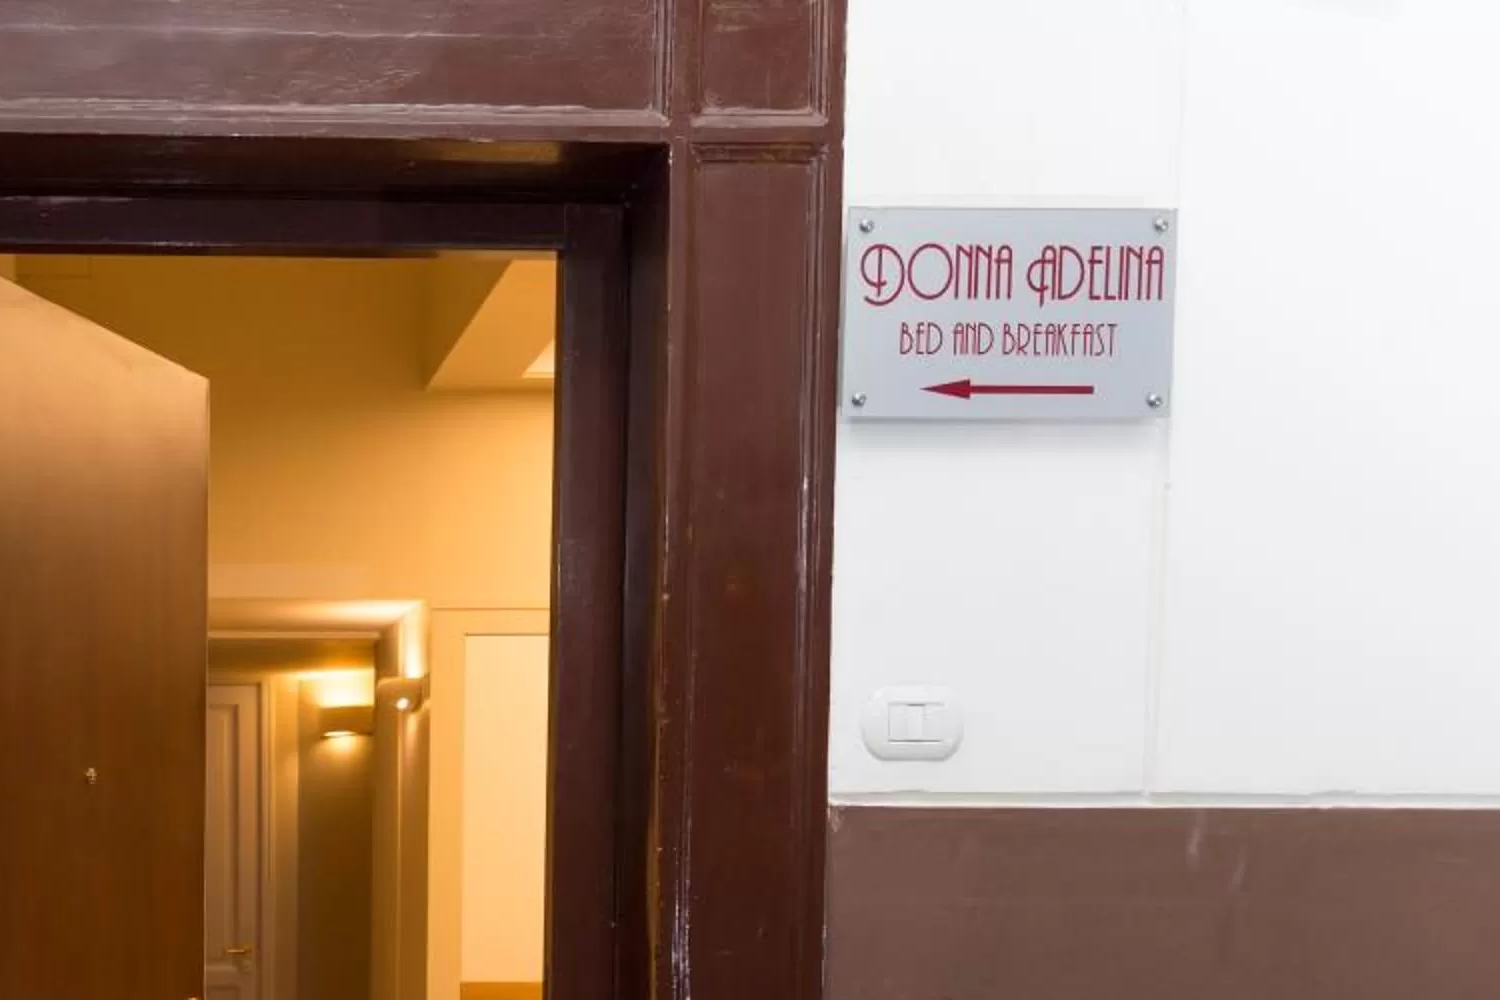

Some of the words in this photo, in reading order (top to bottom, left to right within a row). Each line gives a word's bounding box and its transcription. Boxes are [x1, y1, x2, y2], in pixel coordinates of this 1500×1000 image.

[860, 243, 1014, 306] DONNA
[1026, 244, 1165, 307] ADELINA
[900, 322, 943, 355] BED
[953, 322, 994, 355] AND
[1002, 322, 1118, 357] BREAKFAST
